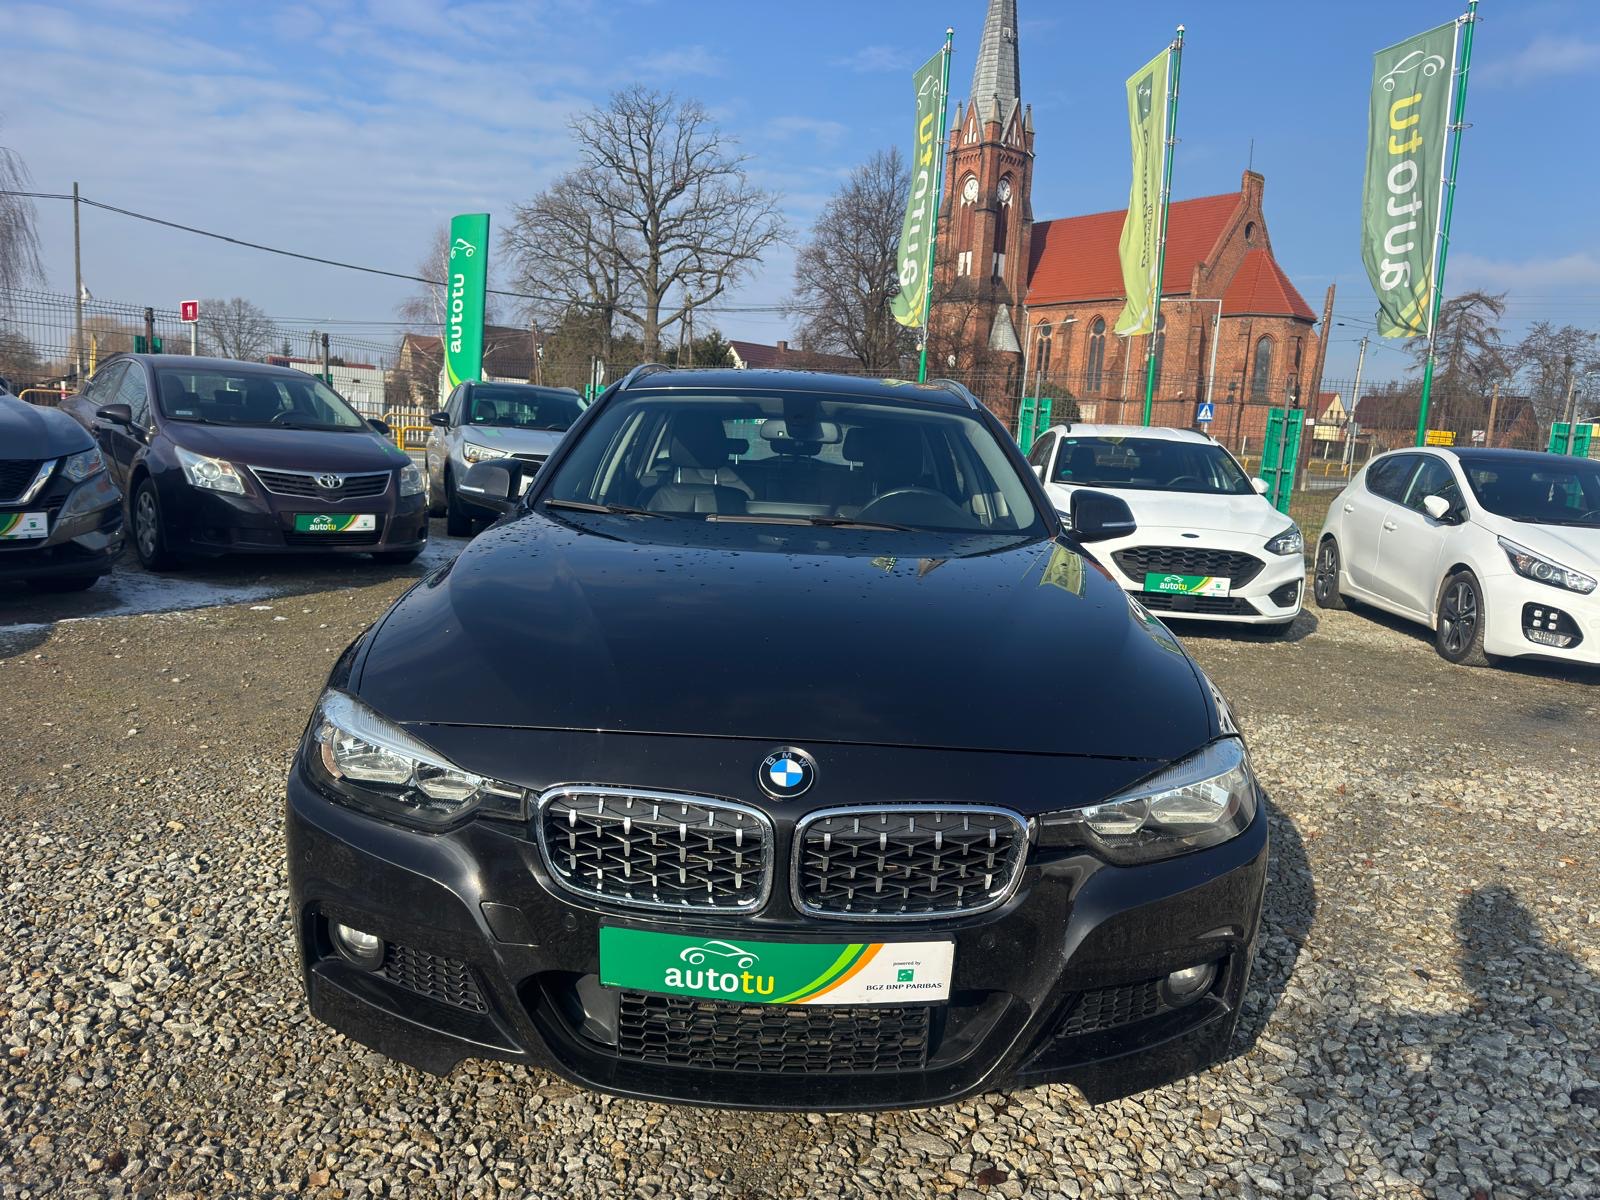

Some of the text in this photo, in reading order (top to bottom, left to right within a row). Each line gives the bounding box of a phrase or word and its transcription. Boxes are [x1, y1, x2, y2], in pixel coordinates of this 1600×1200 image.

[450, 273, 465, 354] autotu
[309, 523, 337, 531] autotu
[1159, 582, 1188, 591] autotu
[664, 966, 775, 995] autotu
[906, 982, 942, 990] PARIBAS
